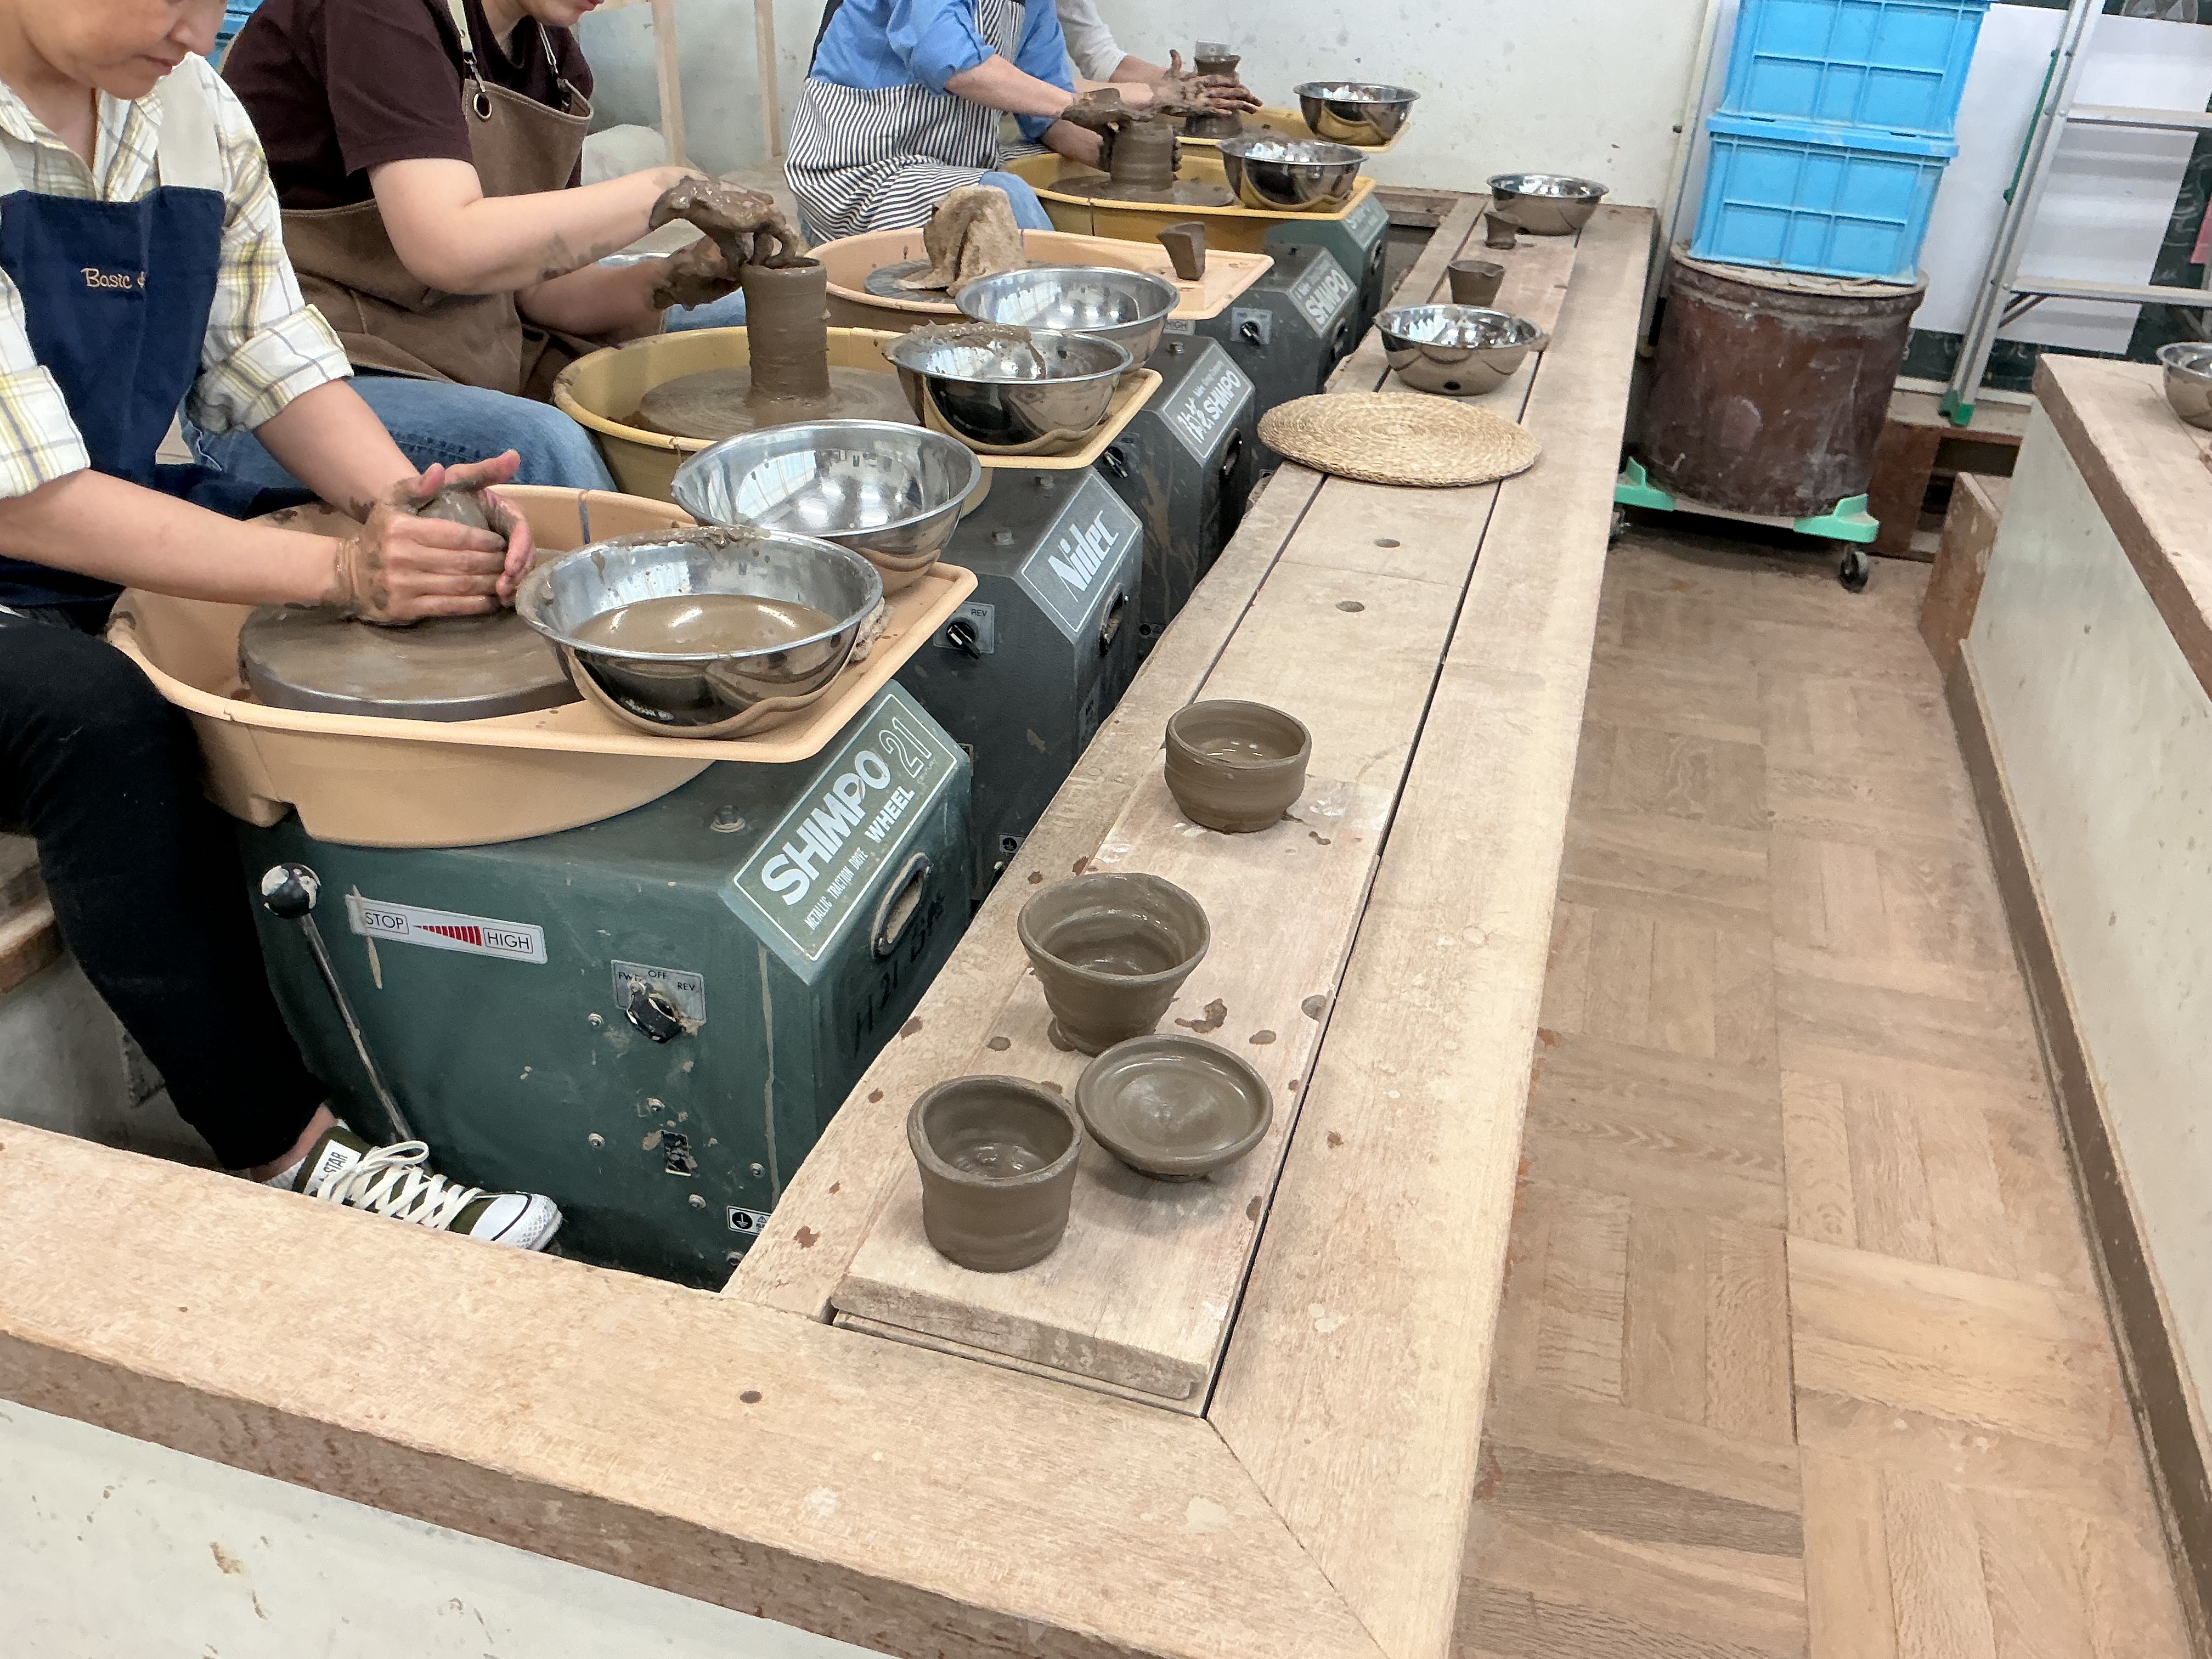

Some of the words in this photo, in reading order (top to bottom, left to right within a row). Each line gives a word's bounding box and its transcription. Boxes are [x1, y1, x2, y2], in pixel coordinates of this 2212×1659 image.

[80, 268, 132, 289] Basic
[1305, 269, 1350, 325] SHIMPO
[1203, 370, 1242, 420] SHIMPO
[971, 608, 988, 617] REV
[761, 750, 891, 906] SHIMPO
[879, 716, 932, 778] 21
[804, 896, 833, 930] METALLIC
[827, 867, 855, 899] TRACTION
[848, 847, 870, 871] DRIVE
[864, 785, 916, 843] WHEEL
[365, 912, 404, 929] STOP
[487, 932, 530, 950] HIGH
[648, 970, 668, 979] OFF
[677, 981, 695, 991] REV
[323, 1151, 348, 1173] STAR
